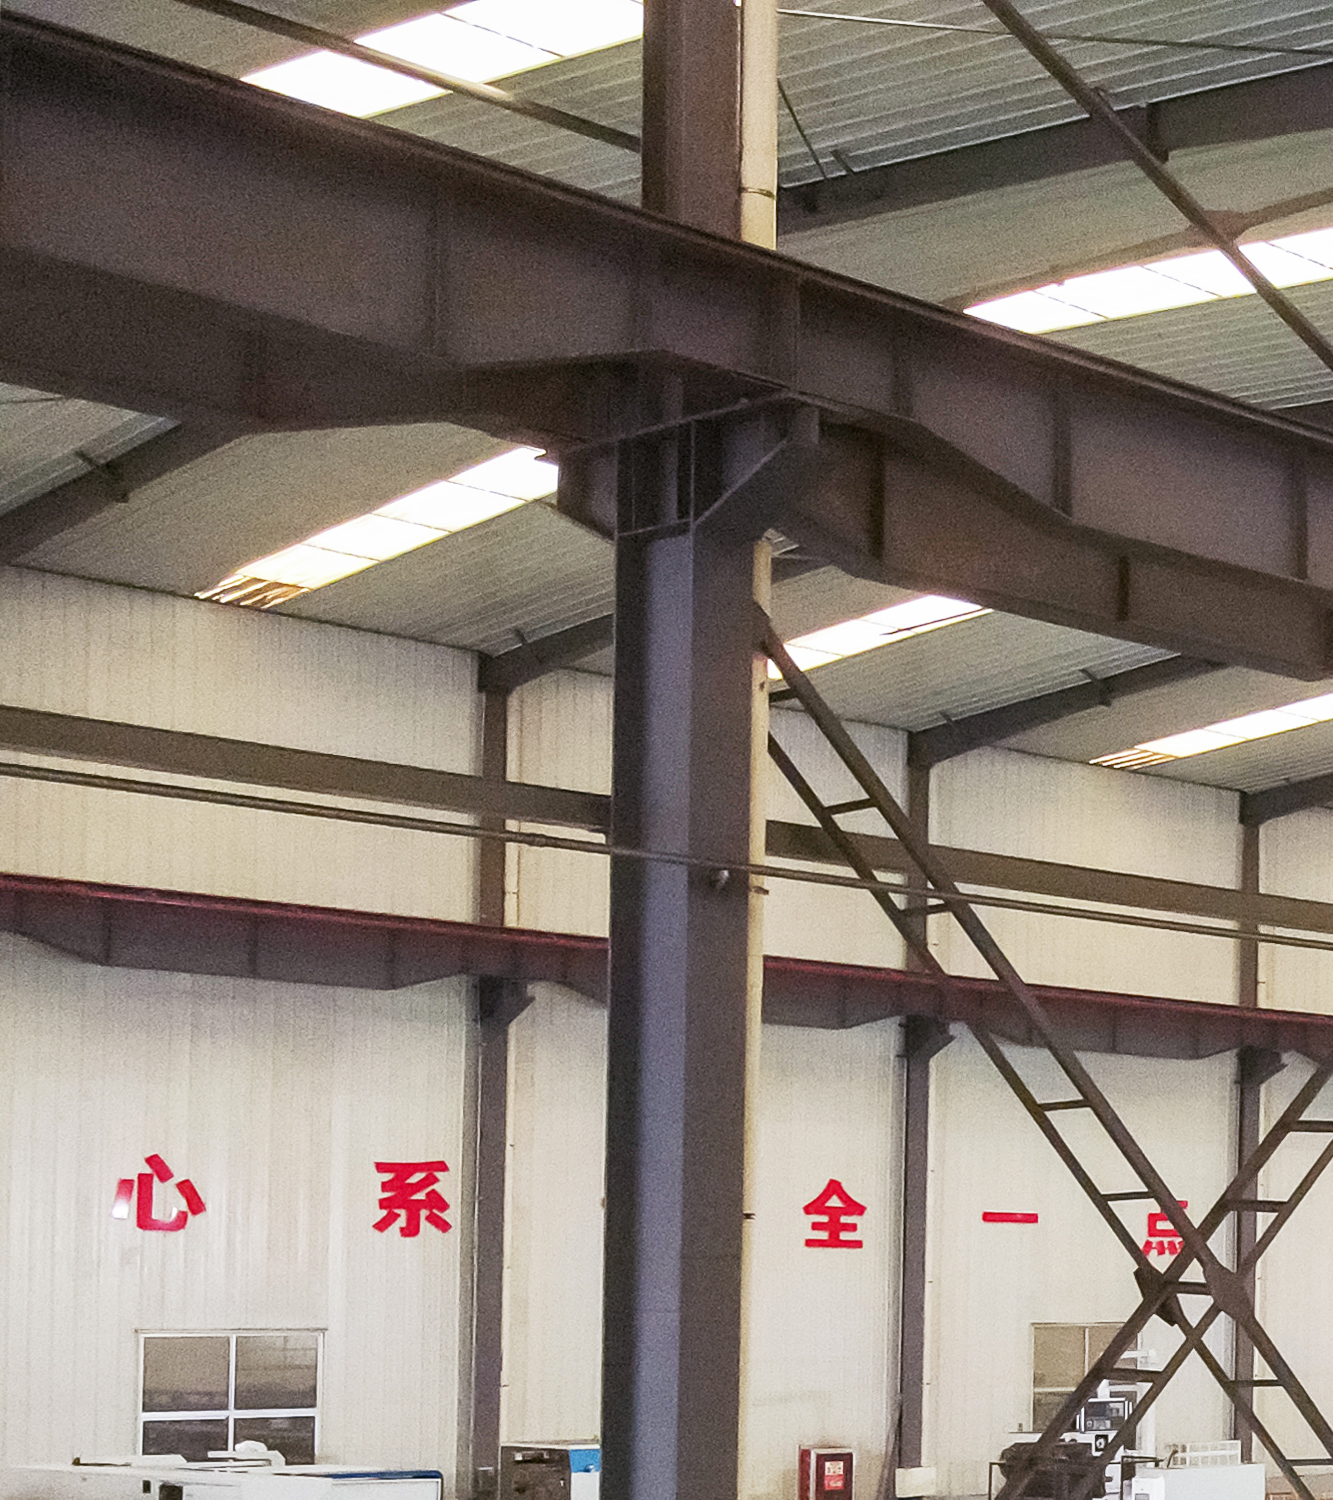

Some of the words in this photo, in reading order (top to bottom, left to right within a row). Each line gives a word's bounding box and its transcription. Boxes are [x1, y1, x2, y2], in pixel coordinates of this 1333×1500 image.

[112, 1154, 206, 1233] 心
[372, 1160, 452, 1238] 系
[802, 1178, 867, 1249] 全
